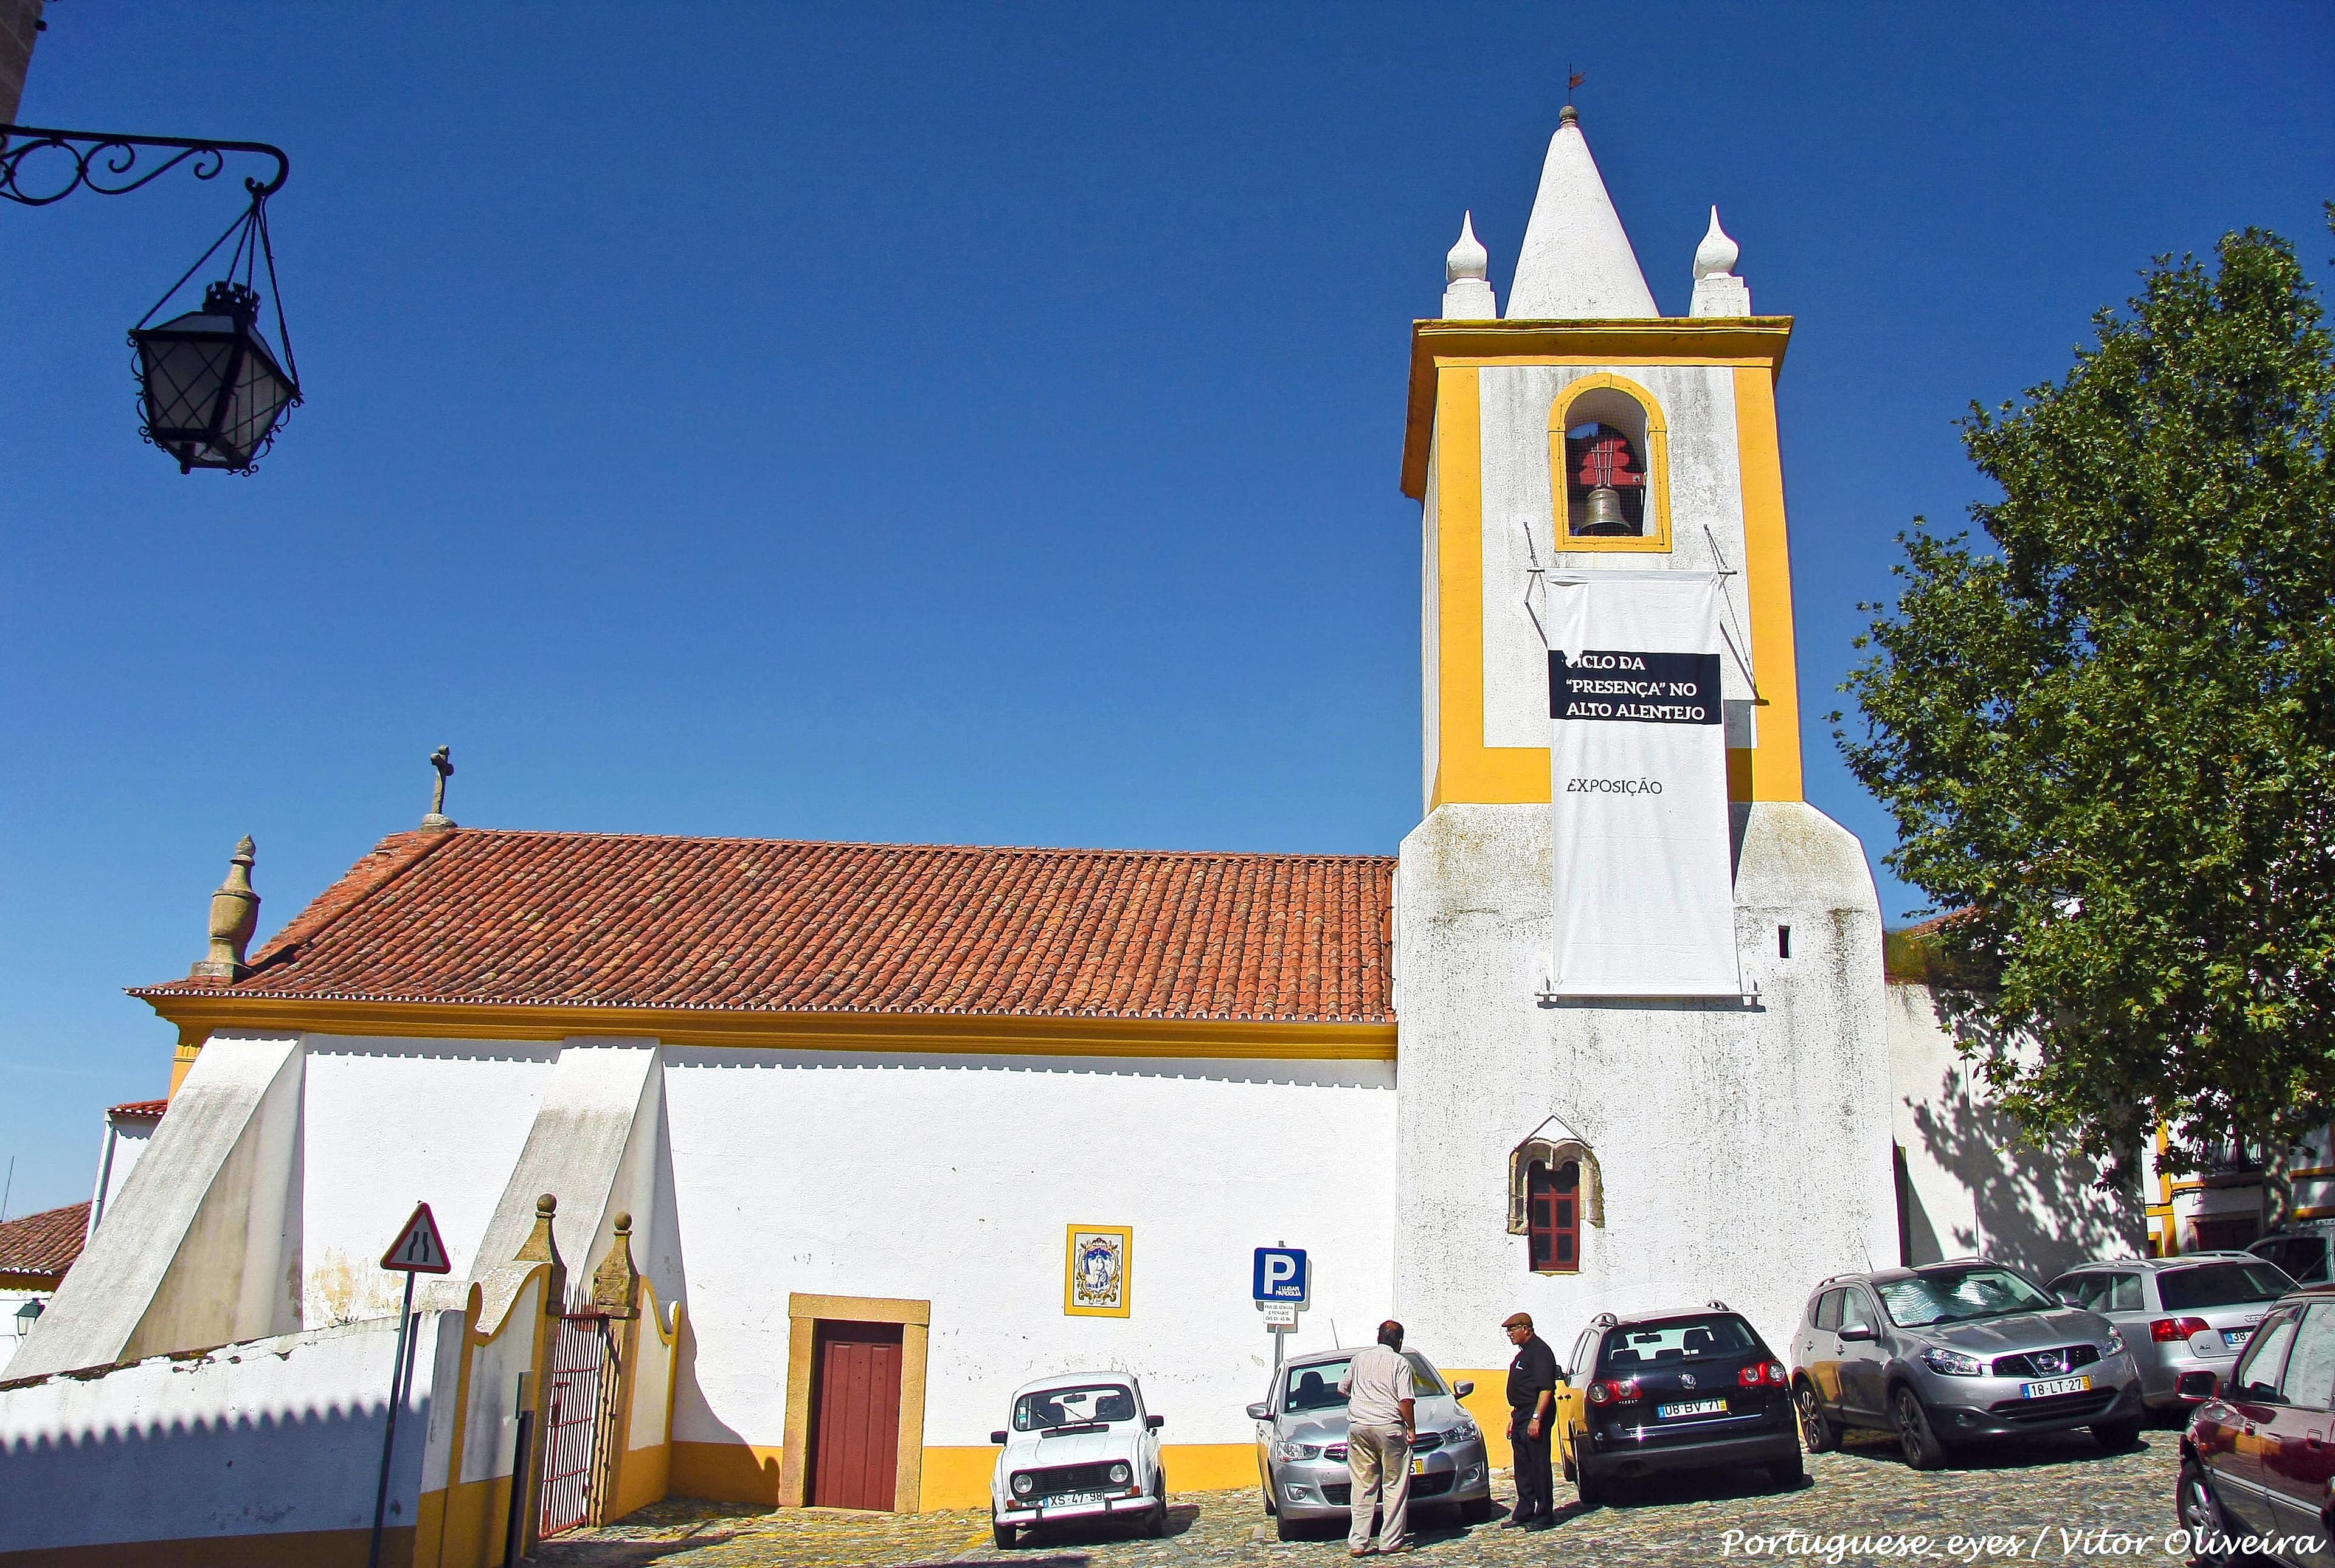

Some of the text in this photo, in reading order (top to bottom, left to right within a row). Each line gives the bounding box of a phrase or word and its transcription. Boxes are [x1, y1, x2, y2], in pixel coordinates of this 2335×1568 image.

[1618, 656, 1646, 670] DA
[1566, 679, 1697, 698] “PRESENÇA” NO
[1566, 702, 1705, 720] ALTO ALENTEJO
[1566, 776, 1662, 796] EXPOSIÇÃO
[1264, 1254, 1296, 1294] P
